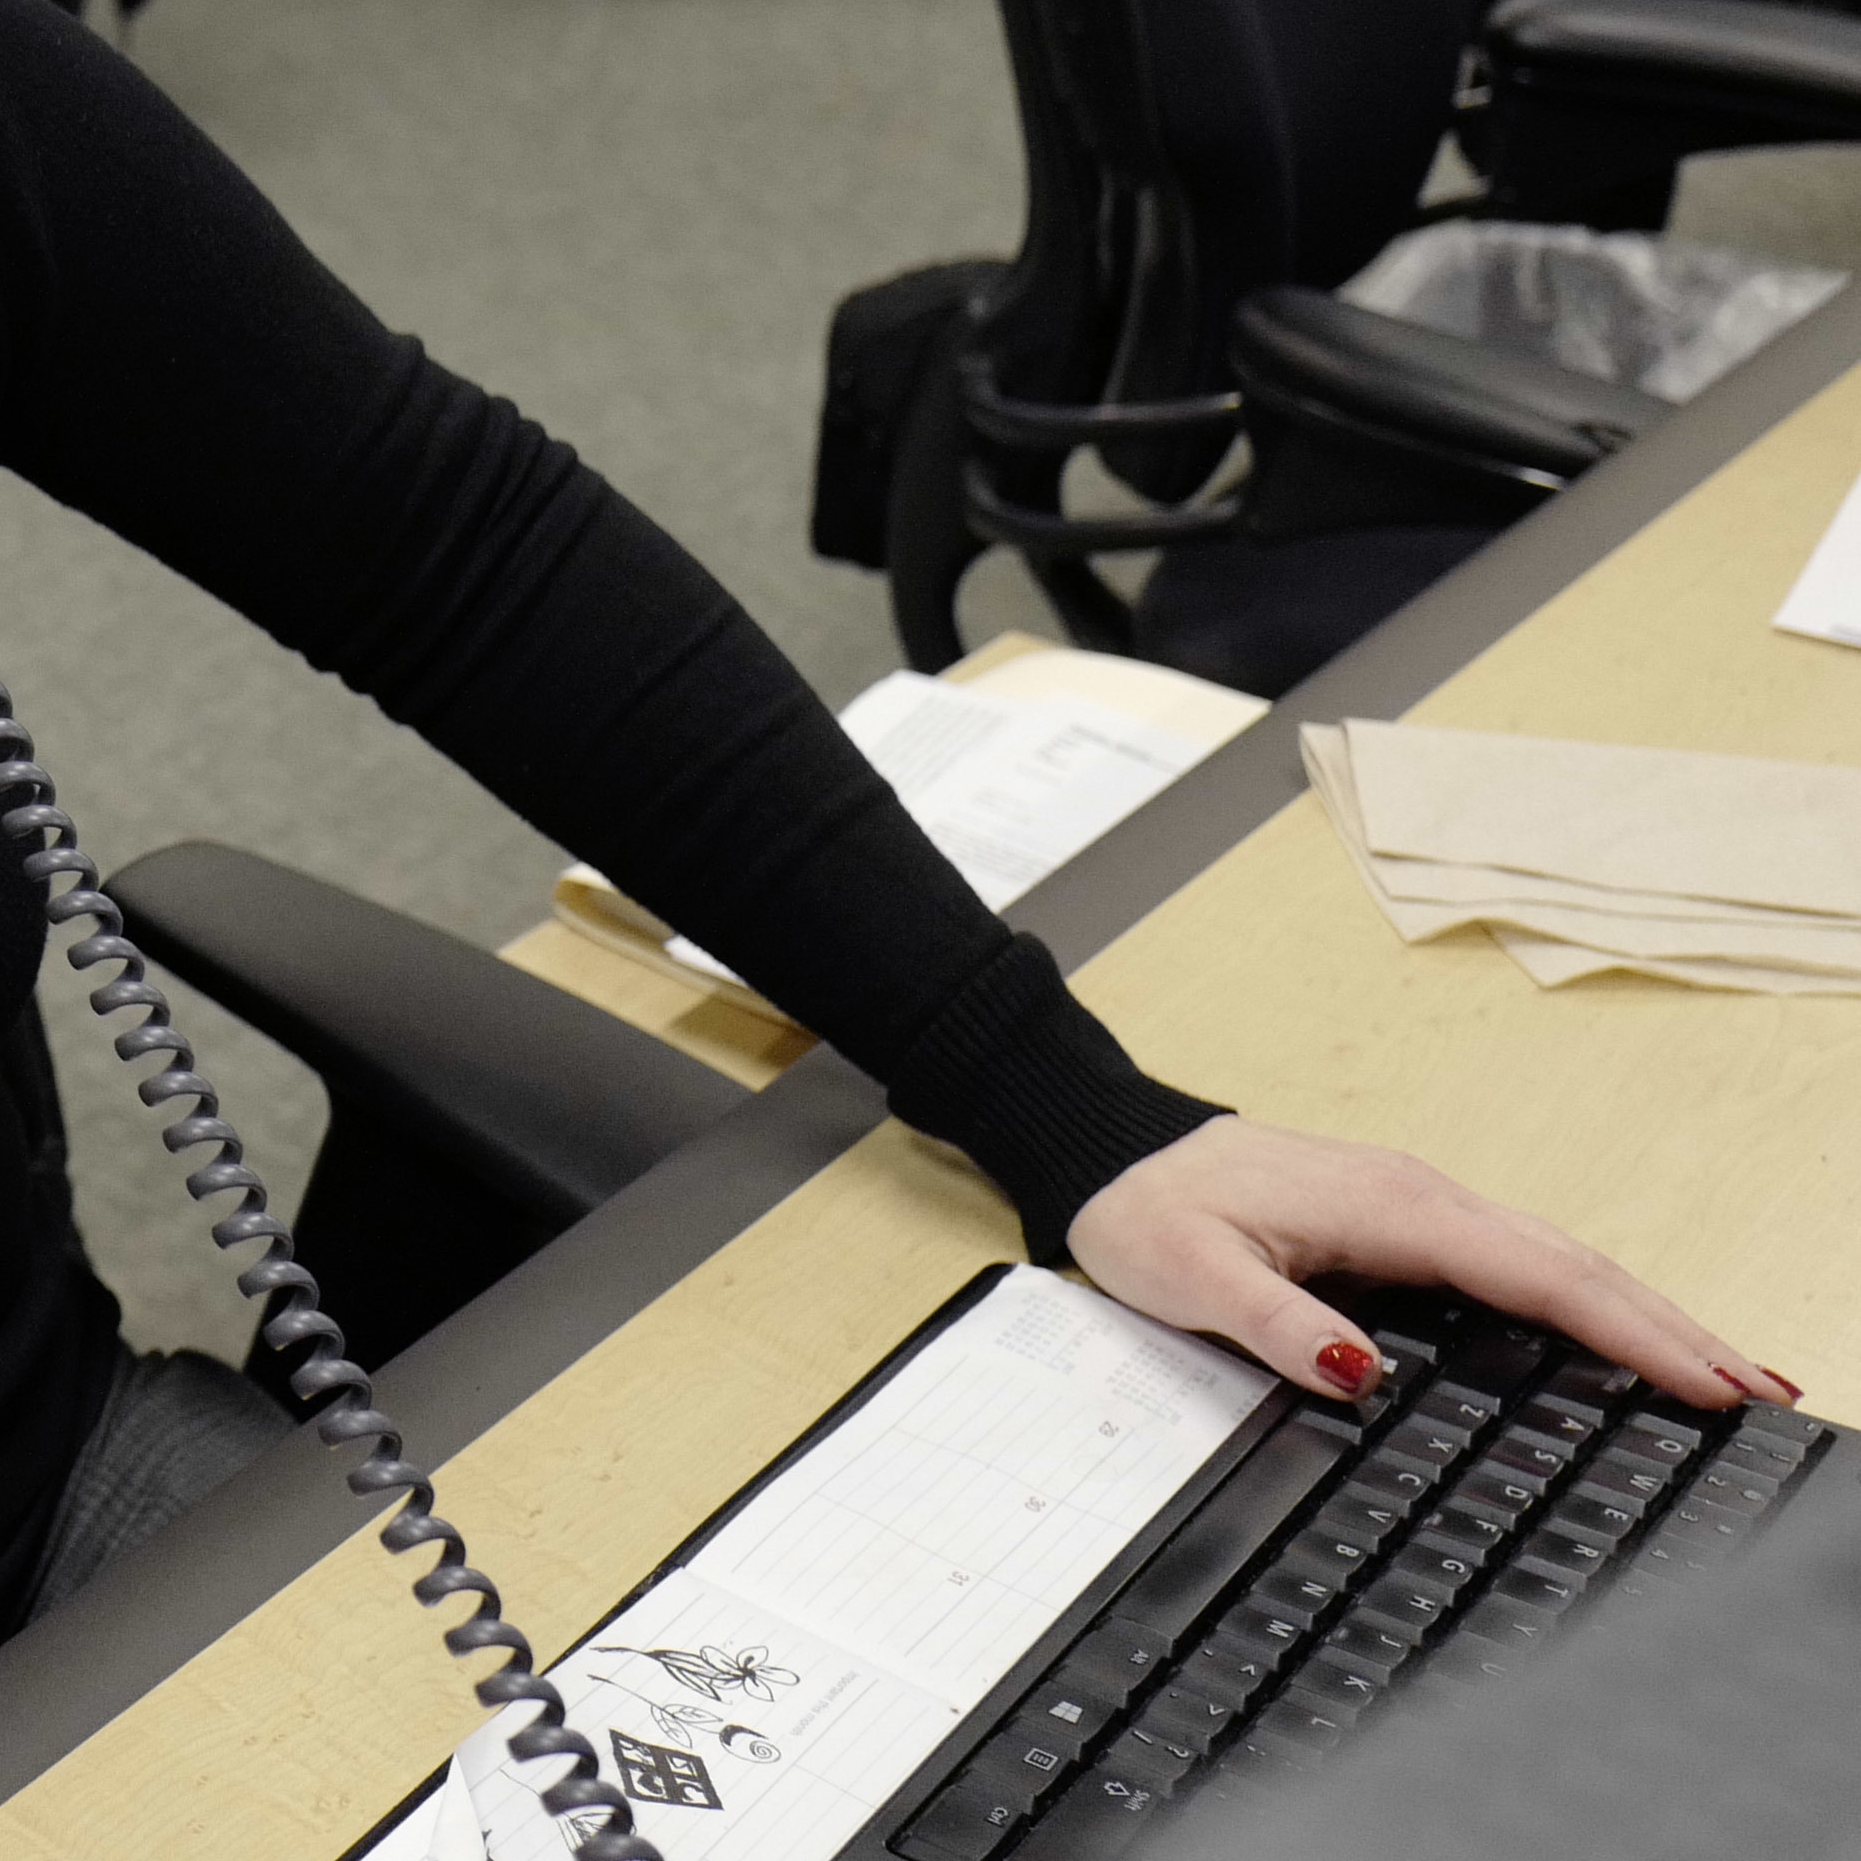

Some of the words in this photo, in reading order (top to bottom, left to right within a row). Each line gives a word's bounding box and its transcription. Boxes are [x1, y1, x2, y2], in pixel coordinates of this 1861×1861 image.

[1459, 1404, 1485, 1418] Z
[1561, 1417, 1585, 1431] A
[1428, 1437, 1453, 1453] X
[1655, 1439, 1684, 1453] Q
[1534, 1450, 1557, 1464] S
[1398, 1473, 1422, 1486] C
[1629, 1474, 1658, 1491] W
[1707, 1475, 1727, 1486] 2
[1505, 1485, 1529, 1499] D
[1024, 1496, 1047, 1513] 30
[1367, 1510, 1392, 1524] V
[1604, 1508, 1629, 1521] E
[1680, 1510, 1699, 1522] 3
[1476, 1519, 1499, 1533] F
[1336, 1544, 1360, 1557] B
[1573, 1544, 1600, 1558] R
[1652, 1549, 1670, 1559] 4
[1441, 1559, 1466, 1574] G
[947, 1571, 970, 1587] 31
[1301, 1581, 1328, 1598] N
[1545, 1585, 1569, 1598] T
[1409, 1595, 1436, 1612] H
[1266, 1619, 1294, 1638] M
[1513, 1624, 1538, 1638] Y
[1380, 1635, 1402, 1648] J
[1130, 1649, 1149, 1664] Alt
[1481, 1662, 1507, 1678] U
[1344, 1675, 1371, 1692] K
[1311, 1716, 1337, 1728] L
[1168, 1745, 1190, 1758] ?
[1124, 1789, 1150, 1811] Shift
[987, 1806, 1009, 1825] Ctrl
